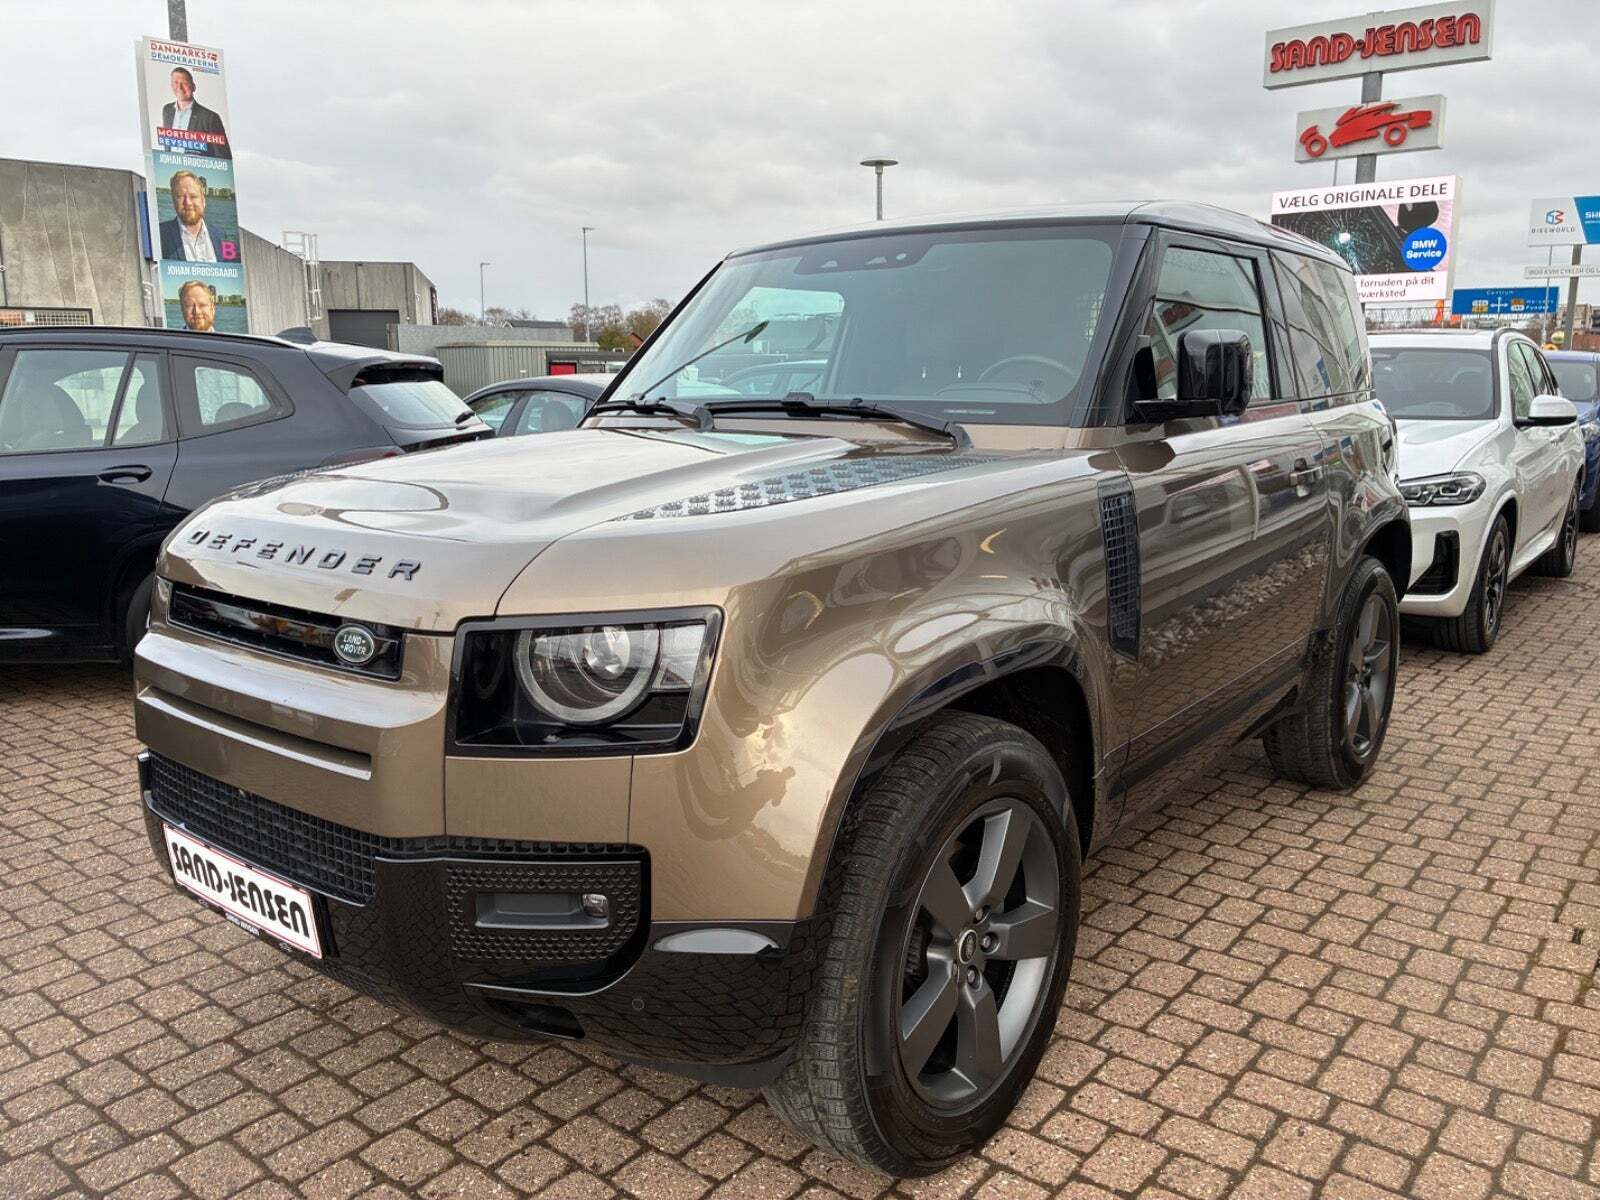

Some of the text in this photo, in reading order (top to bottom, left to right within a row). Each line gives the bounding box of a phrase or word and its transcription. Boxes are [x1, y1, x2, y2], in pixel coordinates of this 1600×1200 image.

[150, 42, 206, 60] DANMARKS
[151, 52, 219, 69] DEMOKRATERNE
[158, 128, 225, 144] MORTEN VEHL
[159, 154, 182, 165] JOHAN
[1279, 182, 1448, 210] VÆLG ORIGINALE DELE
[220, 240, 237, 260] B
[1411, 239, 1438, 250] BMW
[1406, 248, 1442, 260] Service
[167, 265, 190, 276] JOHAN
[1360, 276, 1434, 289] forruden på dit
[187, 529, 422, 582] DEFENDER
[343, 634, 362, 645] LAND
[343, 643, 367, 655] ROVER
